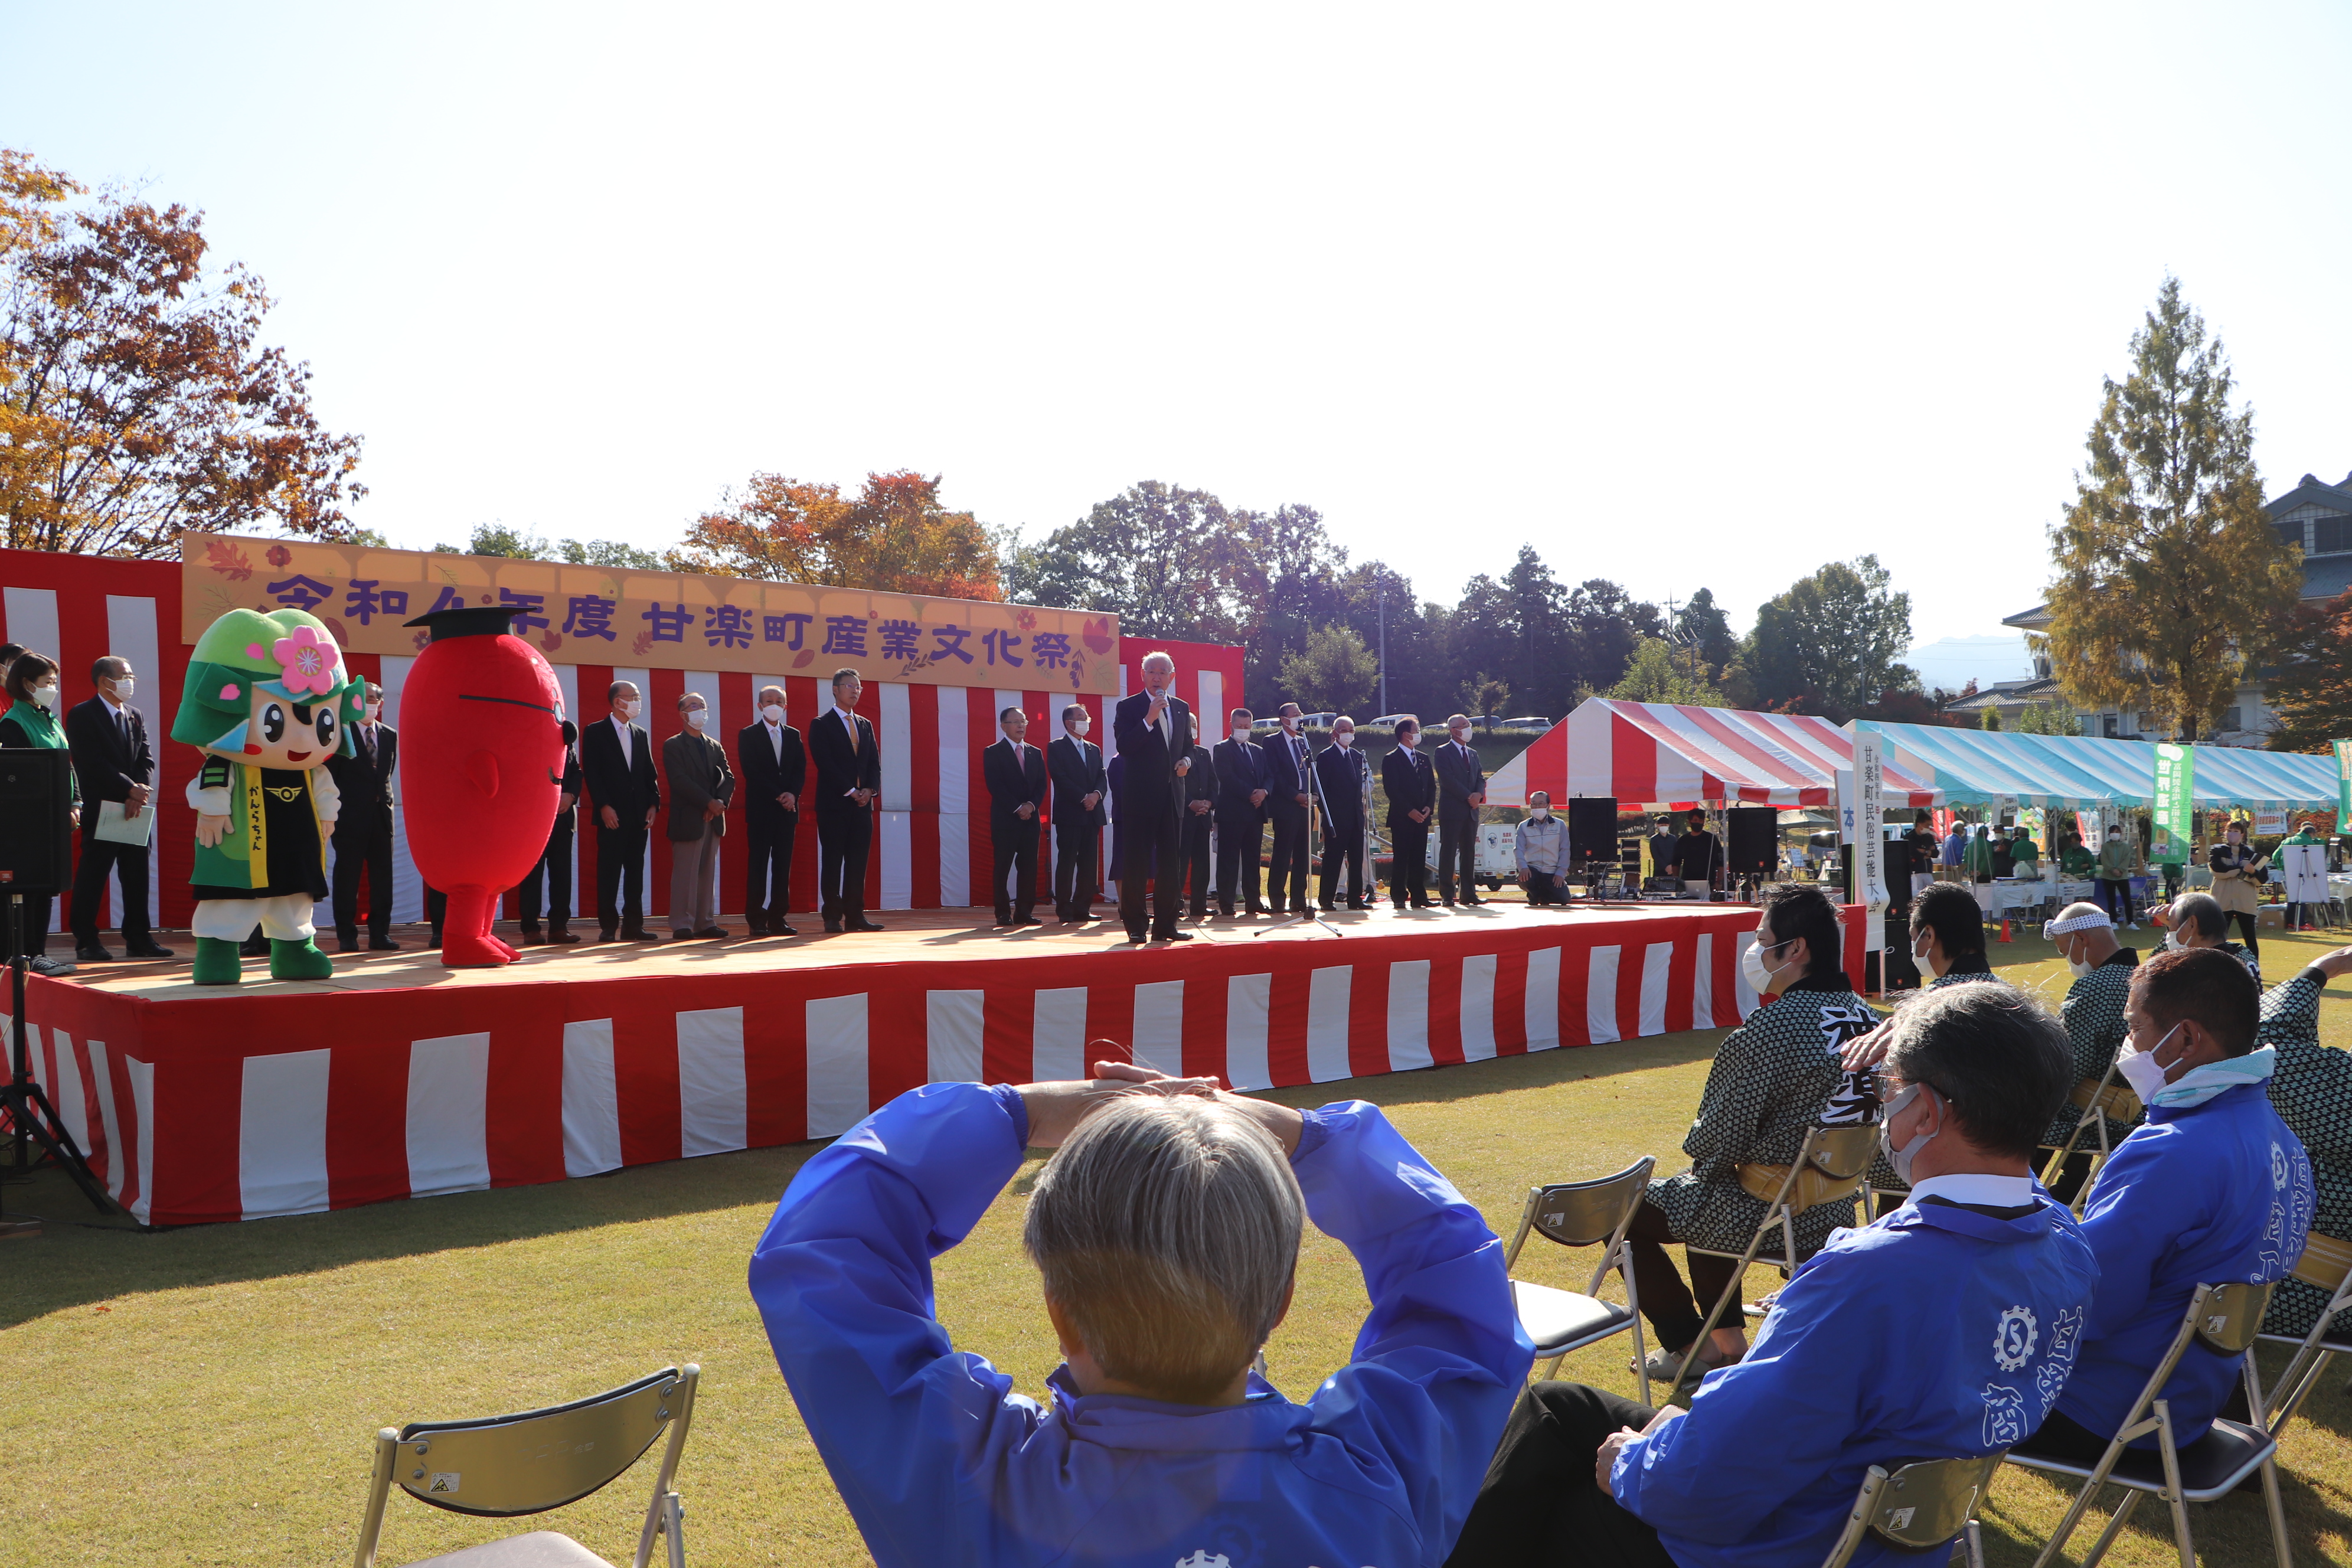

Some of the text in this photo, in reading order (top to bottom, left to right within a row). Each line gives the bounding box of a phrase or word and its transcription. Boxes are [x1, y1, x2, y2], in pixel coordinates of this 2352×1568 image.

[641, 601, 1071, 669] 甘楽町産業文化祭
[249, 786, 262, 851] がんらちゃん
[1864, 746, 1881, 913] 甘楽町民俗芸能大会
